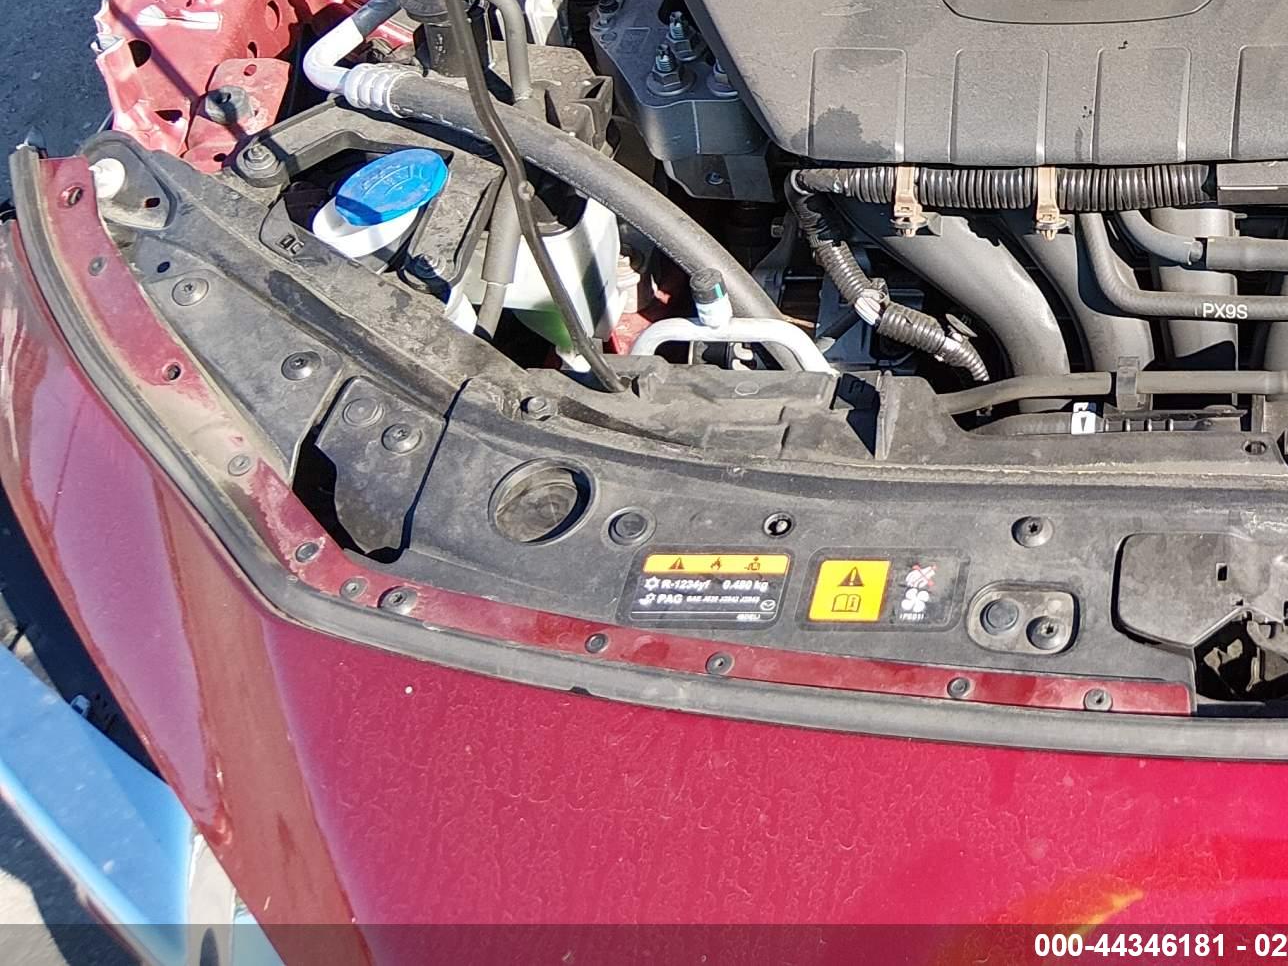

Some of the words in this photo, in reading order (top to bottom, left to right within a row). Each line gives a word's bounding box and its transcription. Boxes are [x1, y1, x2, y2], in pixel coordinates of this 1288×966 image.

[1202, 302, 1248, 320] PX9S
[753, 579, 769, 593] kg
[656, 593, 683, 604] PAG
